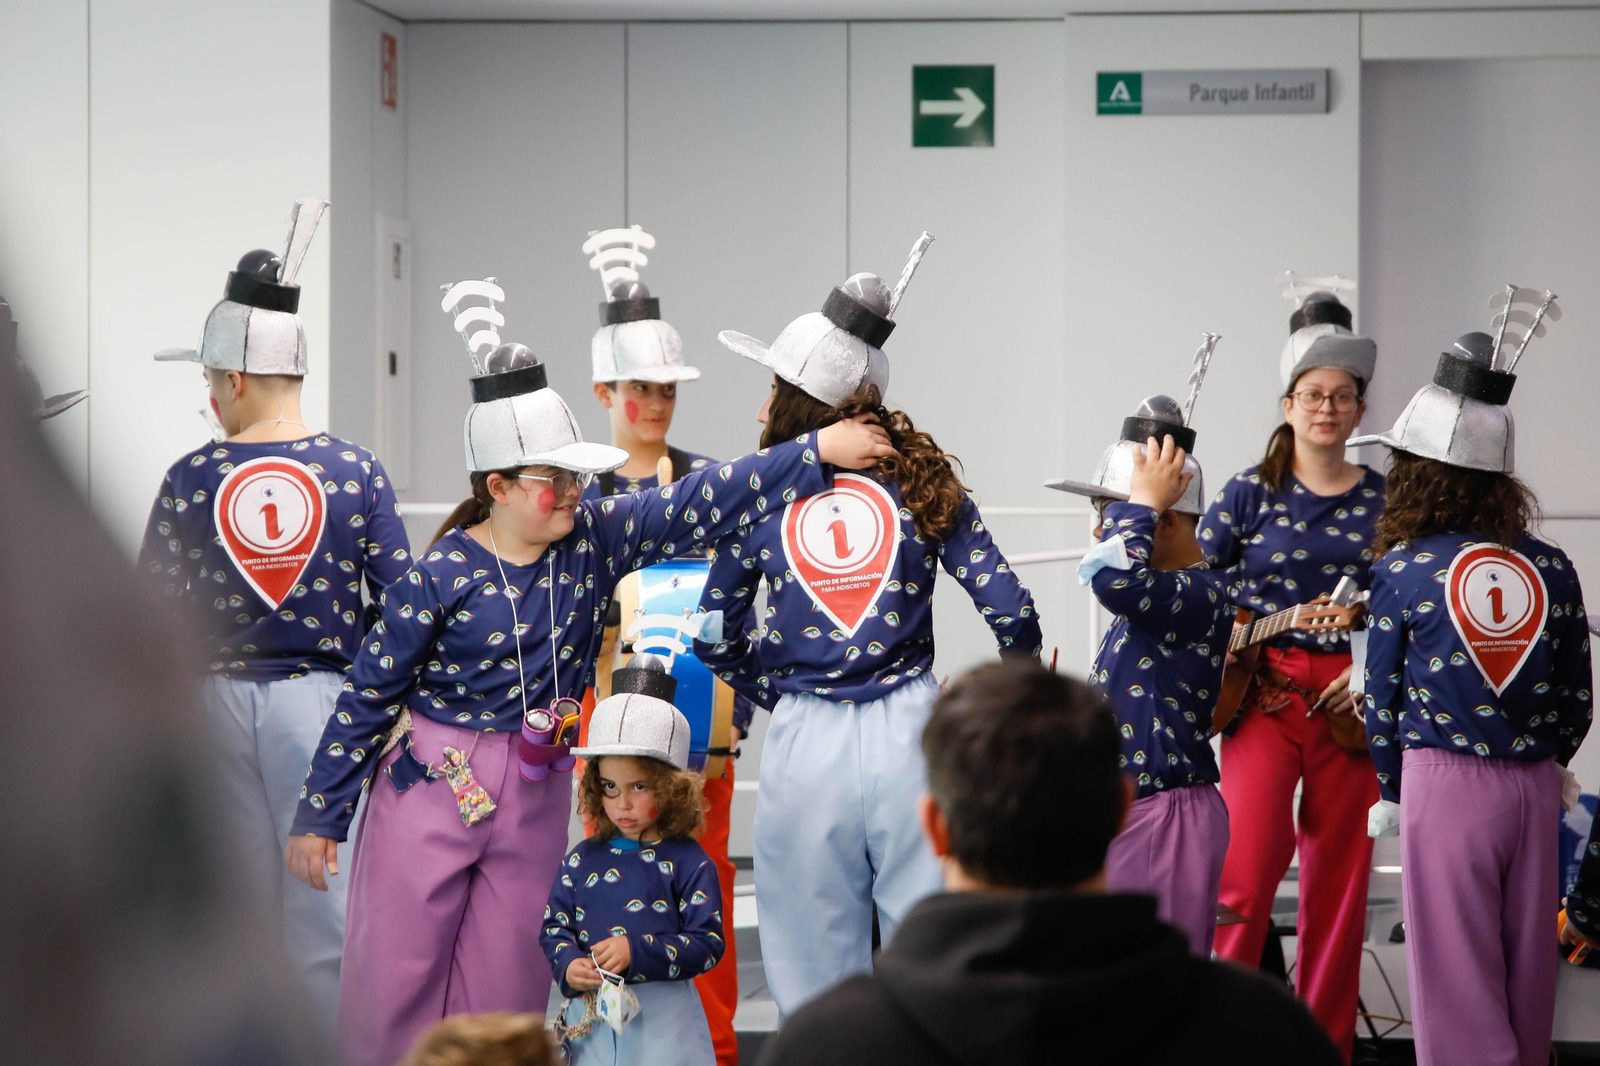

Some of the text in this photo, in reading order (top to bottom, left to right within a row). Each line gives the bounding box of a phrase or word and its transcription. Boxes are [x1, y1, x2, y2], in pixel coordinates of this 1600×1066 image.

[1189, 82, 1316, 104] Parque Infantil
[270, 553, 309, 562] INFORMACIÓN
[266, 561, 298, 569] INDISCRETOS
[810, 579, 831, 587] PUNTO
[840, 572, 882, 582] INFORMACIÓN
[836, 581, 870, 591] INDISCRETOS
